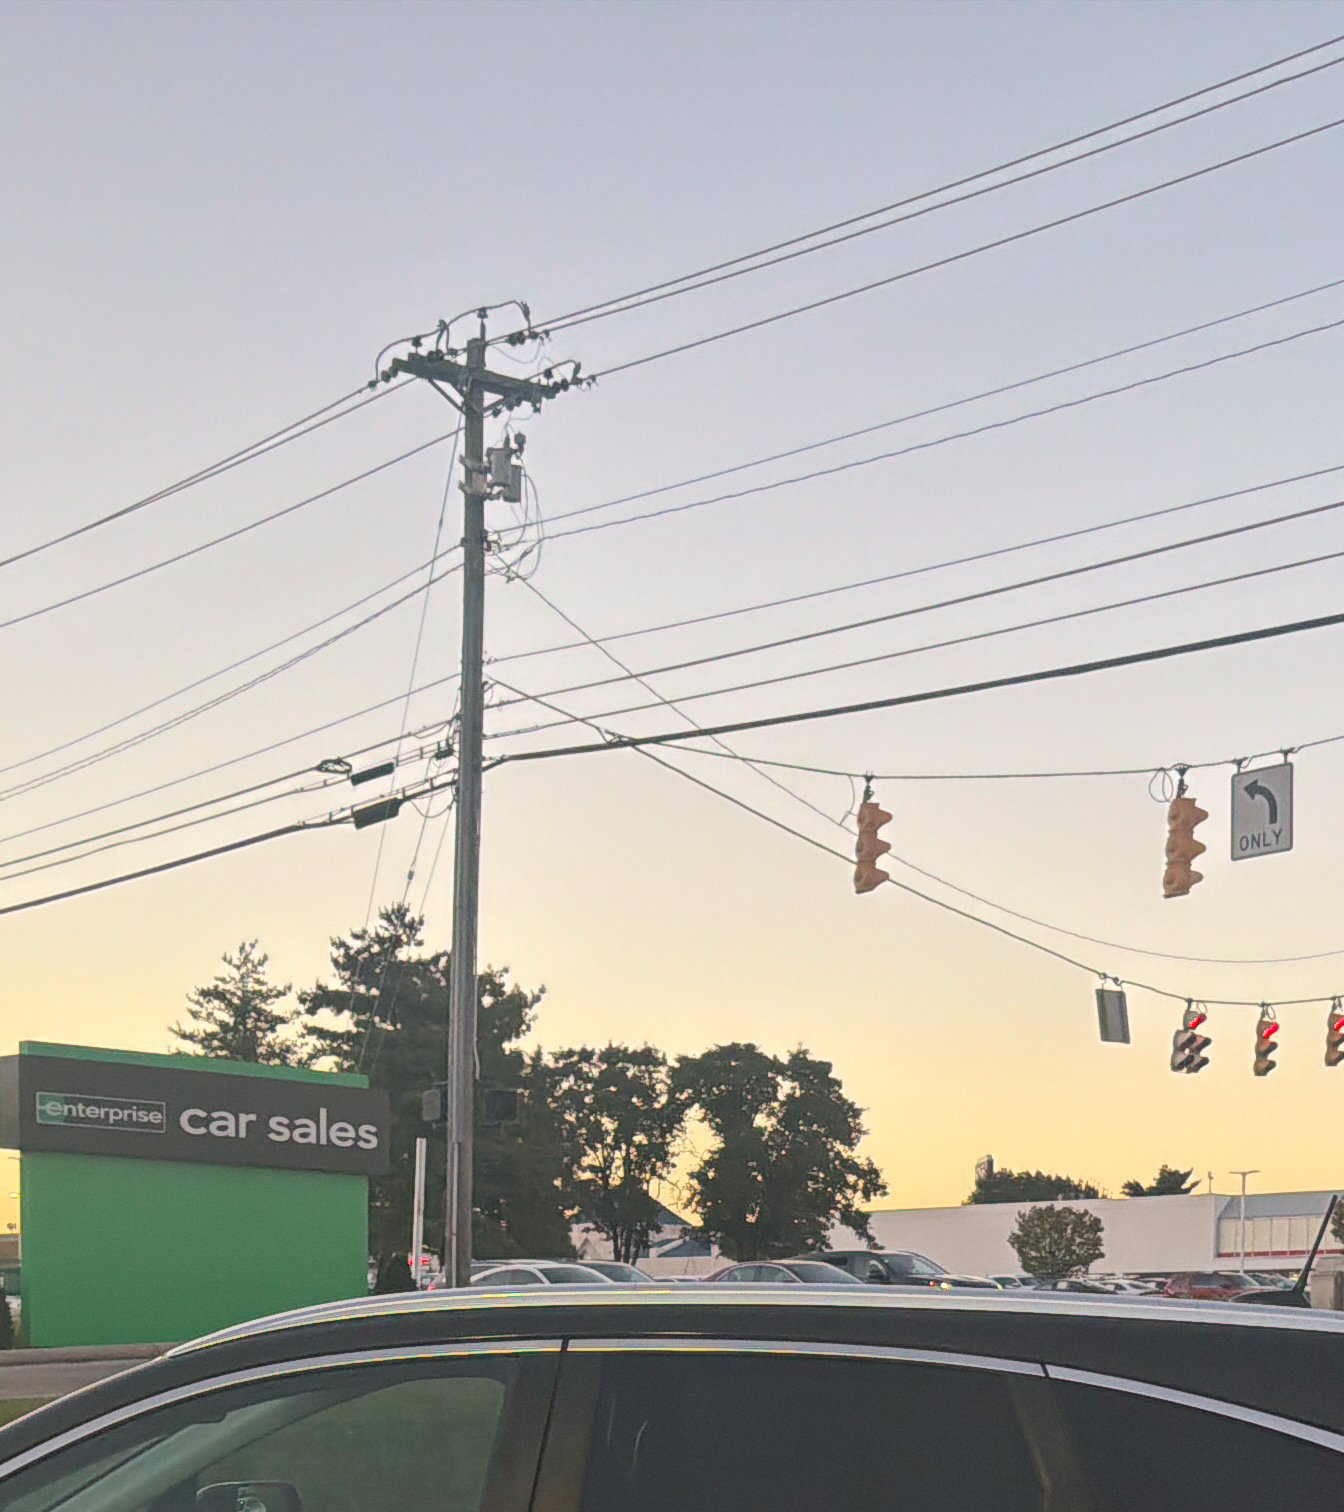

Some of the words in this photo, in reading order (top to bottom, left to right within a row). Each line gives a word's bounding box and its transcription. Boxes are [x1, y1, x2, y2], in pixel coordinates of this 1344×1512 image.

[1239, 829, 1282, 852] ONLY
[45, 1099, 163, 1125] enterprise
[179, 1107, 257, 1139] car
[268, 1107, 379, 1150] sales
